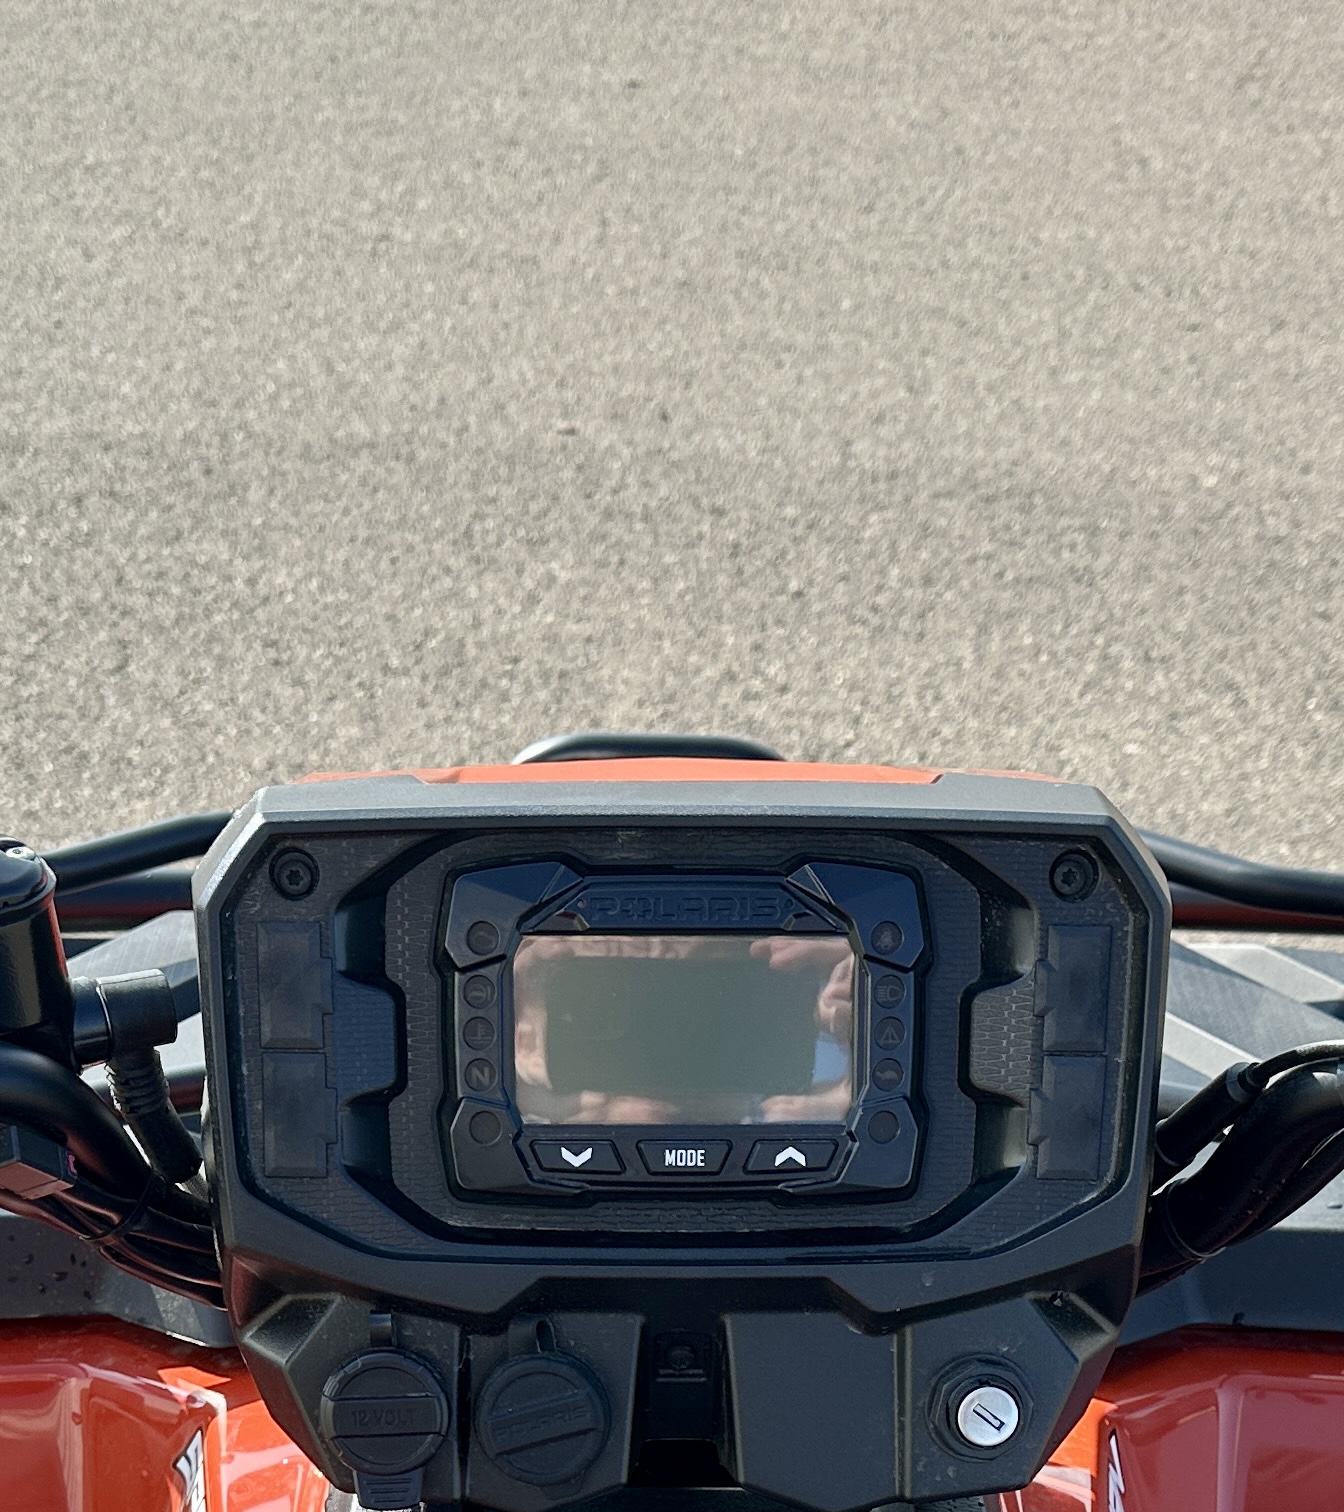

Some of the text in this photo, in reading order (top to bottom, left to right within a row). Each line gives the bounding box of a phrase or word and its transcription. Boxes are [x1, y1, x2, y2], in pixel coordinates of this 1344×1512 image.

[591, 896, 782, 921] POLARIS
[471, 1066, 490, 1085] N
[664, 1149, 706, 1168] MODE
[351, 1406, 417, 1427] 12 VOLT
